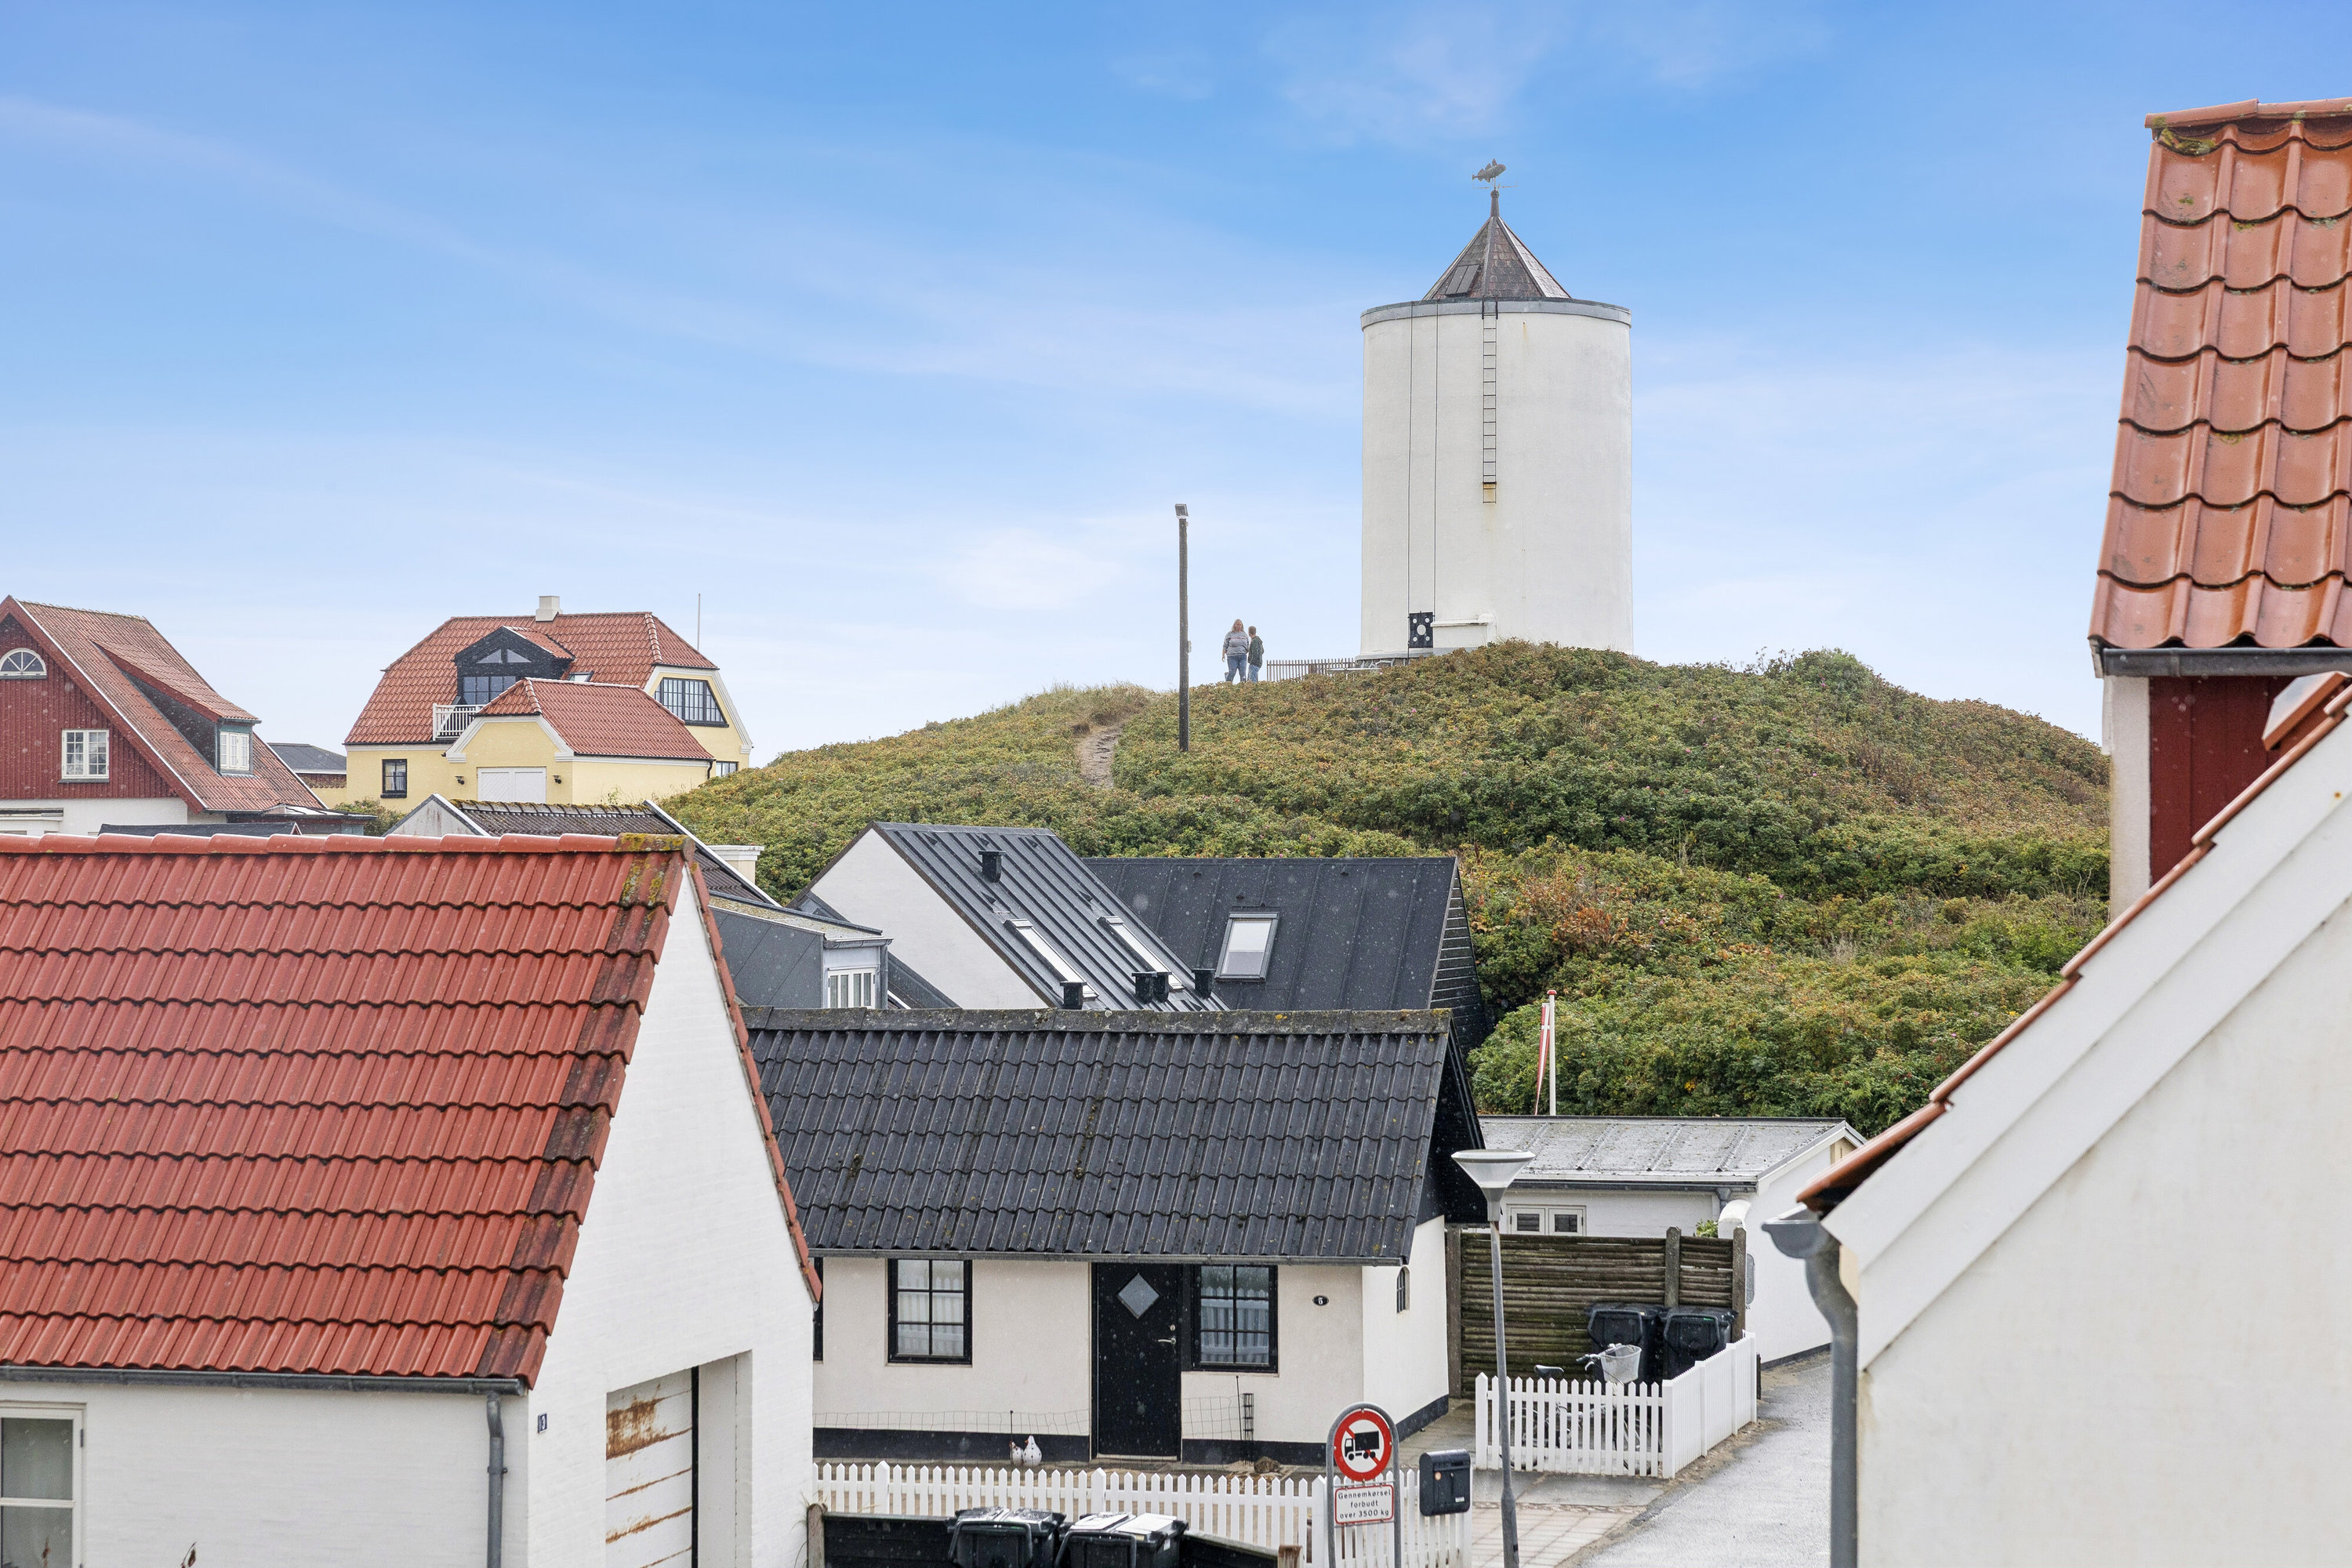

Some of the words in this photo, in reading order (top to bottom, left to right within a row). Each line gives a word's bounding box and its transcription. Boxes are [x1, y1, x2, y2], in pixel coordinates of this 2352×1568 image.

[1318, 1297, 1323, 1305] 5
[1338, 1490, 1391, 1500] Gennemkørsel
[1359, 1509, 1378, 1518] 3500
